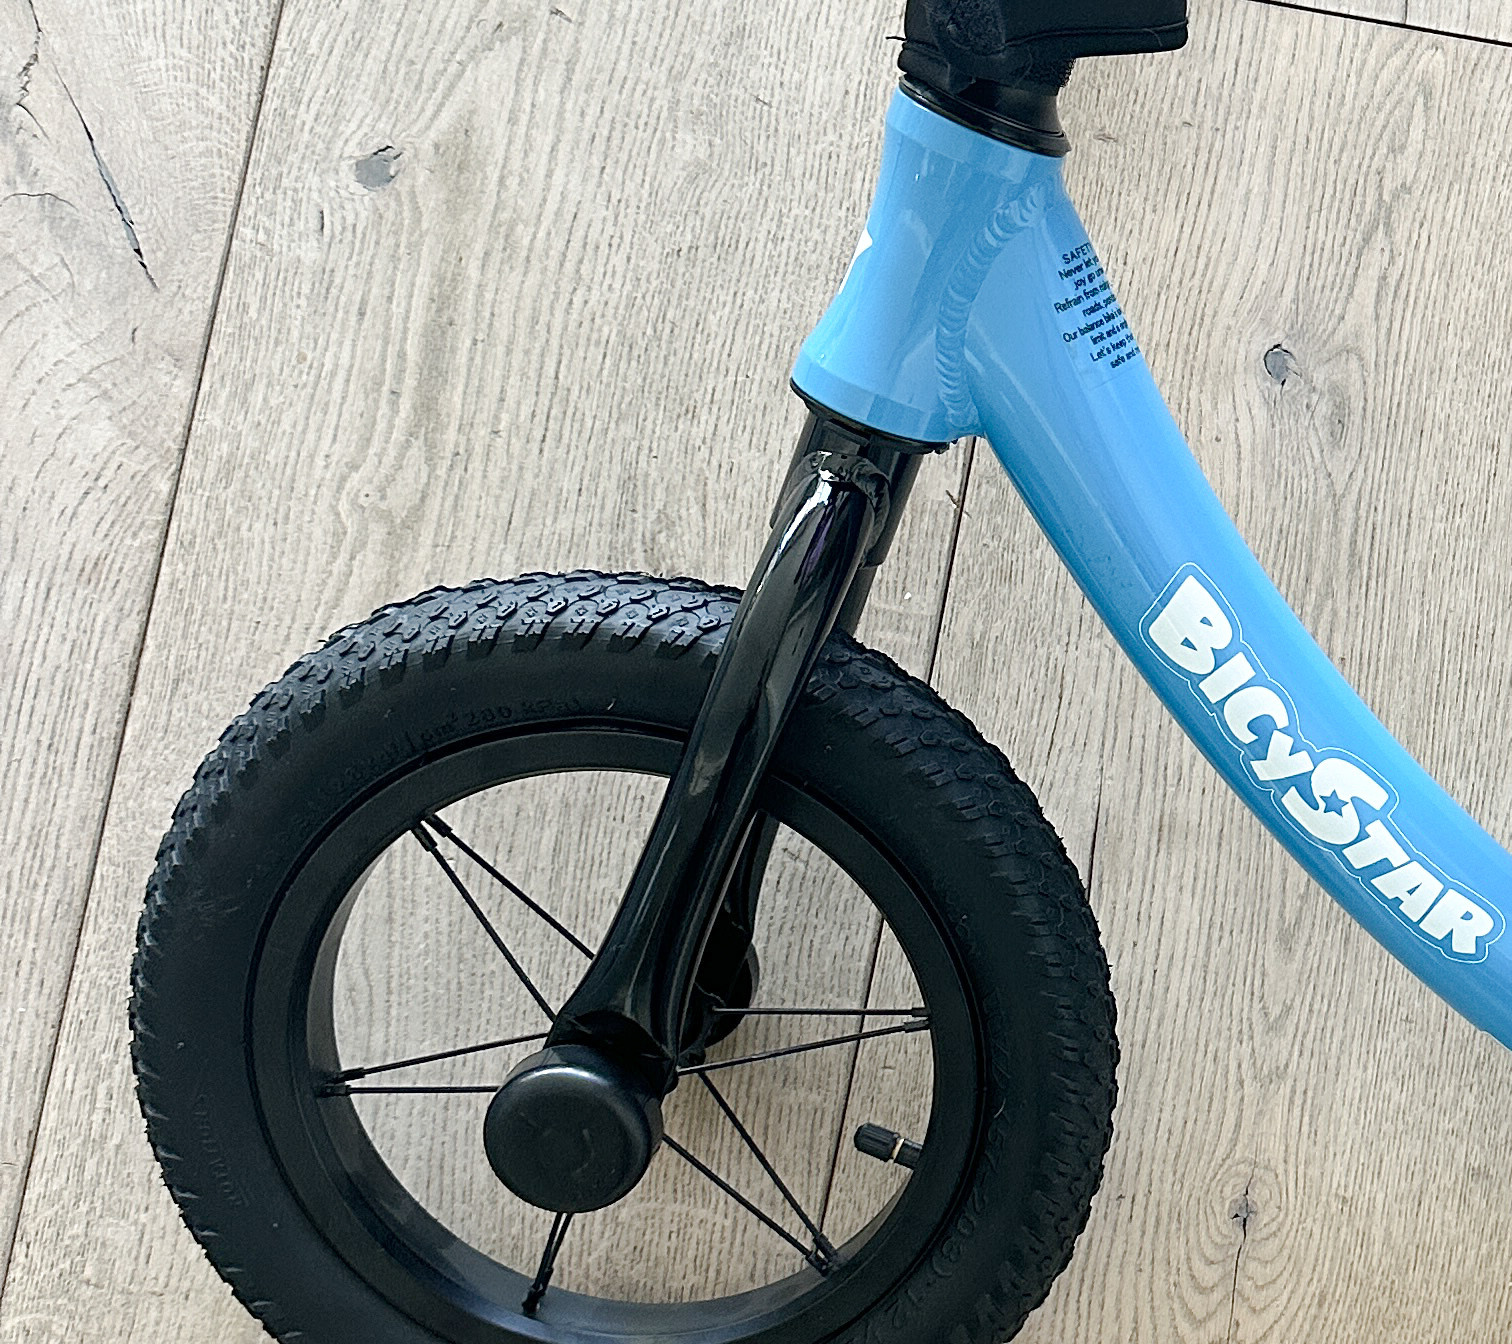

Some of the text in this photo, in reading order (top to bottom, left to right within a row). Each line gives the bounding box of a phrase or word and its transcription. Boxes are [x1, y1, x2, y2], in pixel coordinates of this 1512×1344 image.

[1058, 264, 1083, 280] Never
[1074, 276, 1086, 290] joy
[1054, 294, 1083, 314] Refrain
[1063, 332, 1078, 342] Our
[1090, 345, 1111, 361] Let's
[1110, 353, 1125, 368] safe
